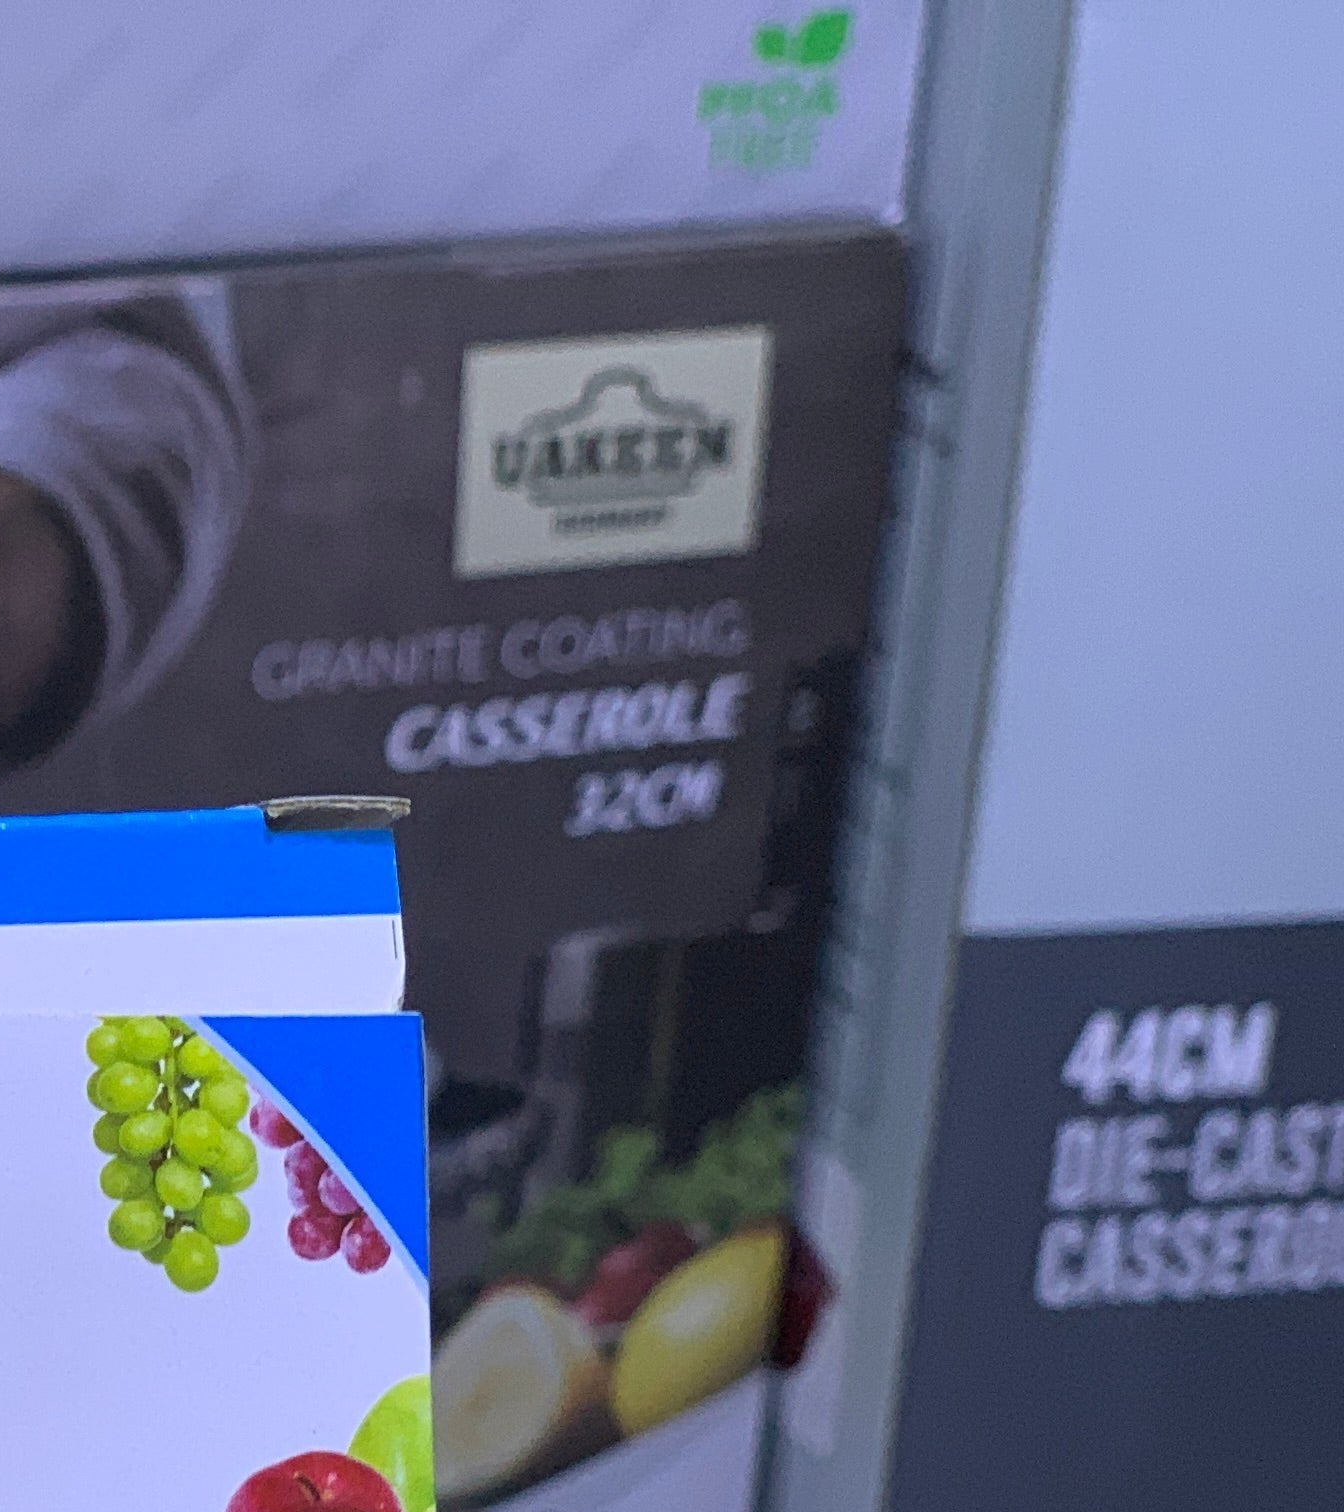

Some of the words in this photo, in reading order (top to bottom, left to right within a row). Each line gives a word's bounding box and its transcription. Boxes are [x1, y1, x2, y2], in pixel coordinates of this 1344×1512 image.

[251, 622, 489, 701] GRANITE
[500, 599, 747, 680] COATING
[383, 672, 750, 775] CASSEROLE
[563, 761, 723, 838] 32CM
[1061, 999, 1278, 1103] 44CM
